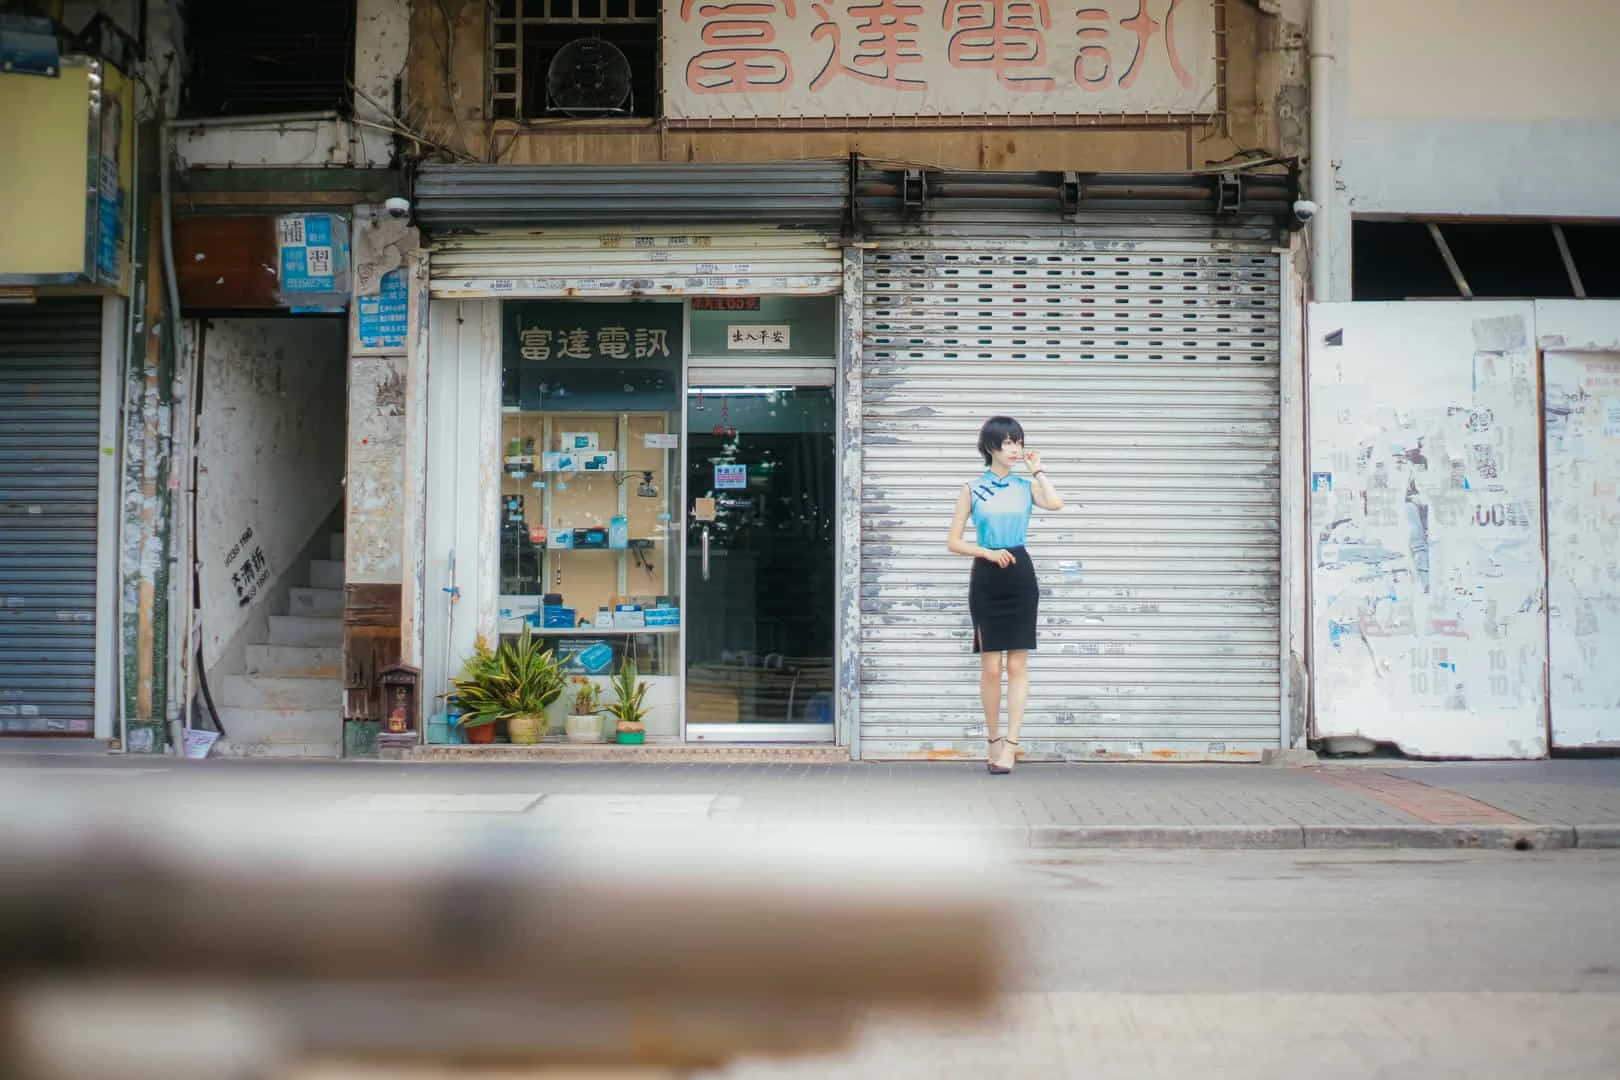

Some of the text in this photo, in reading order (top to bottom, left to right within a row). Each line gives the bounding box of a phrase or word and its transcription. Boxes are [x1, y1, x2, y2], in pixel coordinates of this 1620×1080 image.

[280, 221, 303, 243] 補
[309, 249, 329, 272] 習
[520, 326, 670, 360] 富達電訊
[732, 329, 785, 345] 出入平安
